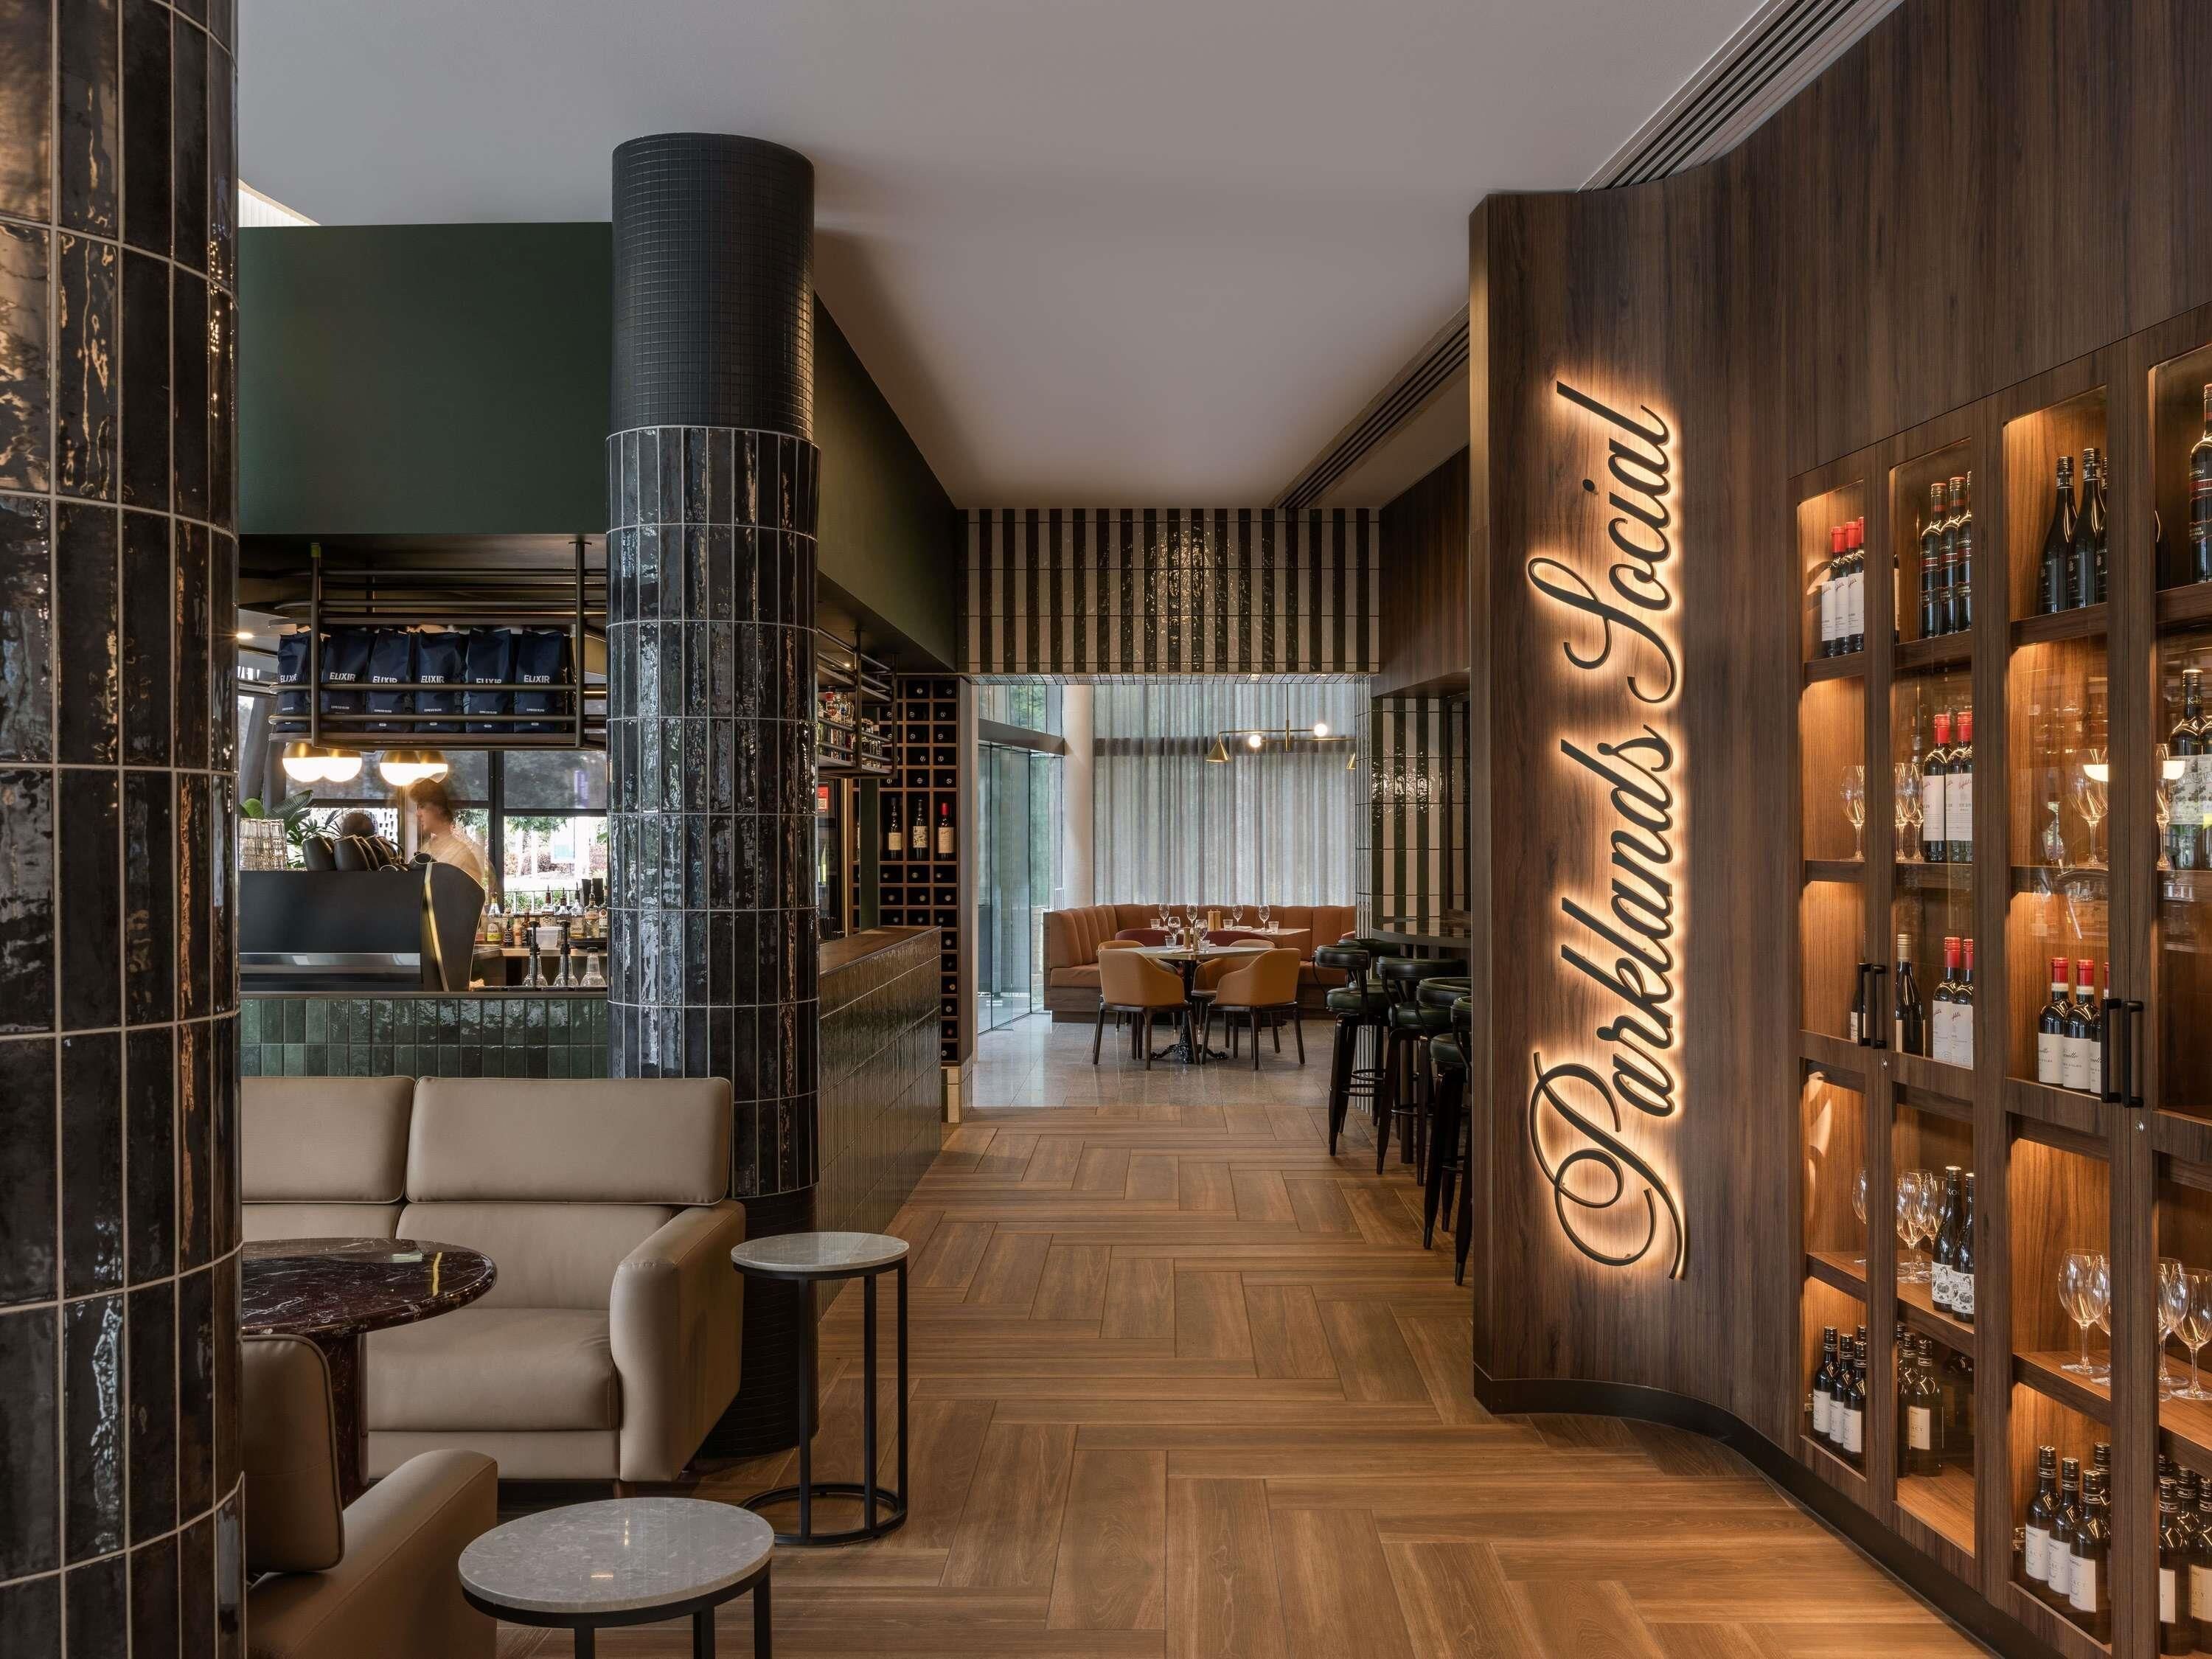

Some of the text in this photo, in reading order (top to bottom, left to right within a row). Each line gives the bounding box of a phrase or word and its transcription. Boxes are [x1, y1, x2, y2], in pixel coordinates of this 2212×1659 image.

[330, 672, 356, 682] ELIXIR
[372, 675, 397, 684] ELIXIR
[420, 675, 445, 684] ELIXIR
[524, 675, 550, 684] ELIXIR
[1527, 380, 1686, 1281] Parklands Social
